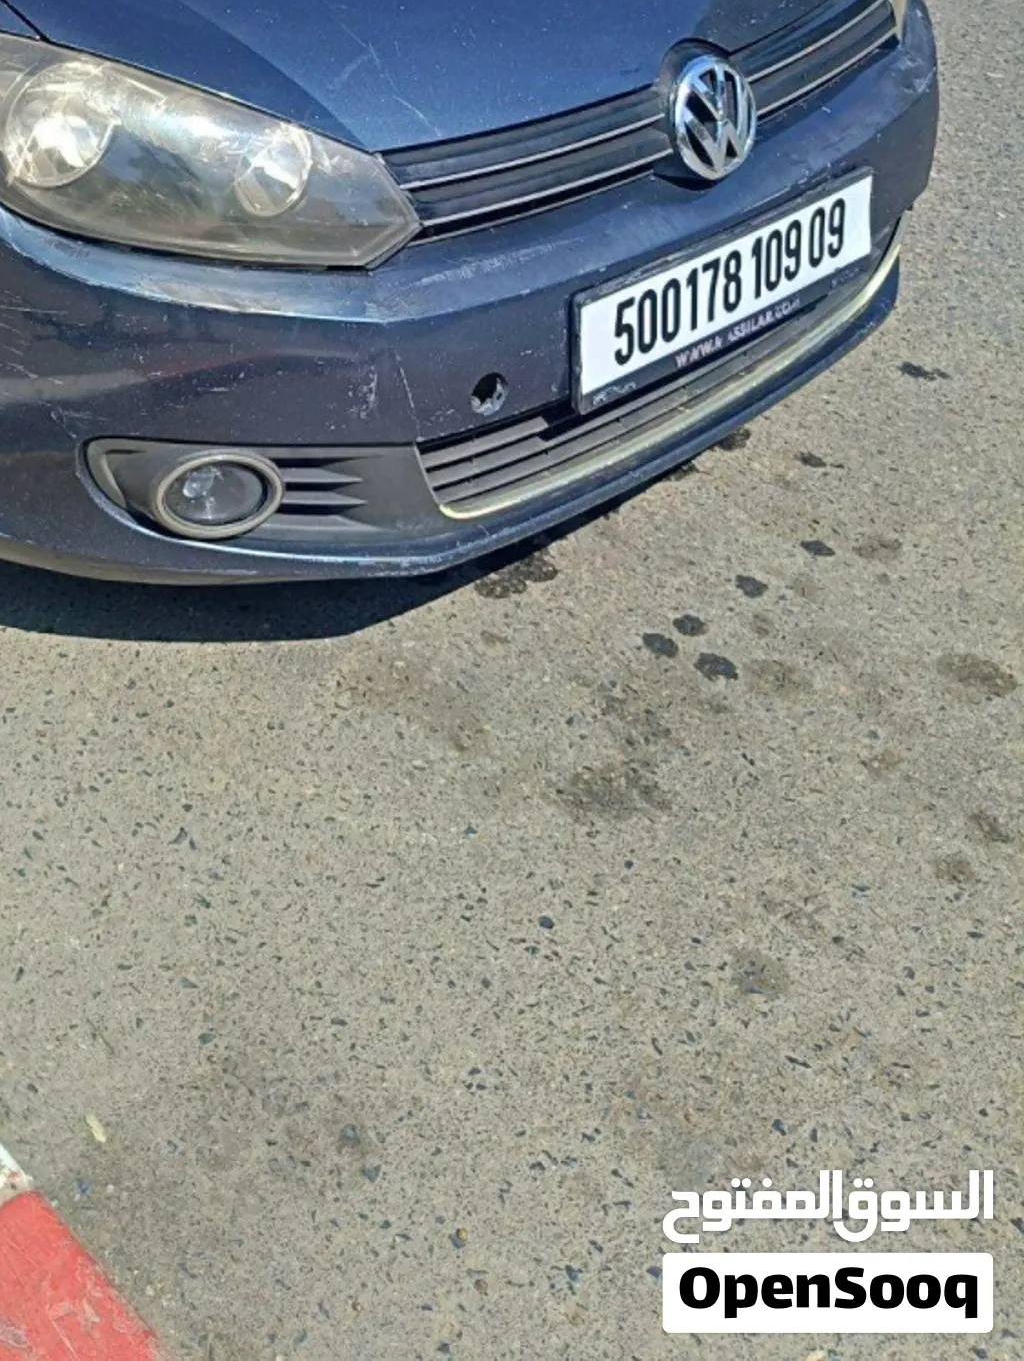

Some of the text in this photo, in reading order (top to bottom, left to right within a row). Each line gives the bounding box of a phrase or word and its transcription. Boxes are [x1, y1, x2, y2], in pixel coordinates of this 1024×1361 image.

[614, 197, 846, 366] 500178 109 09
